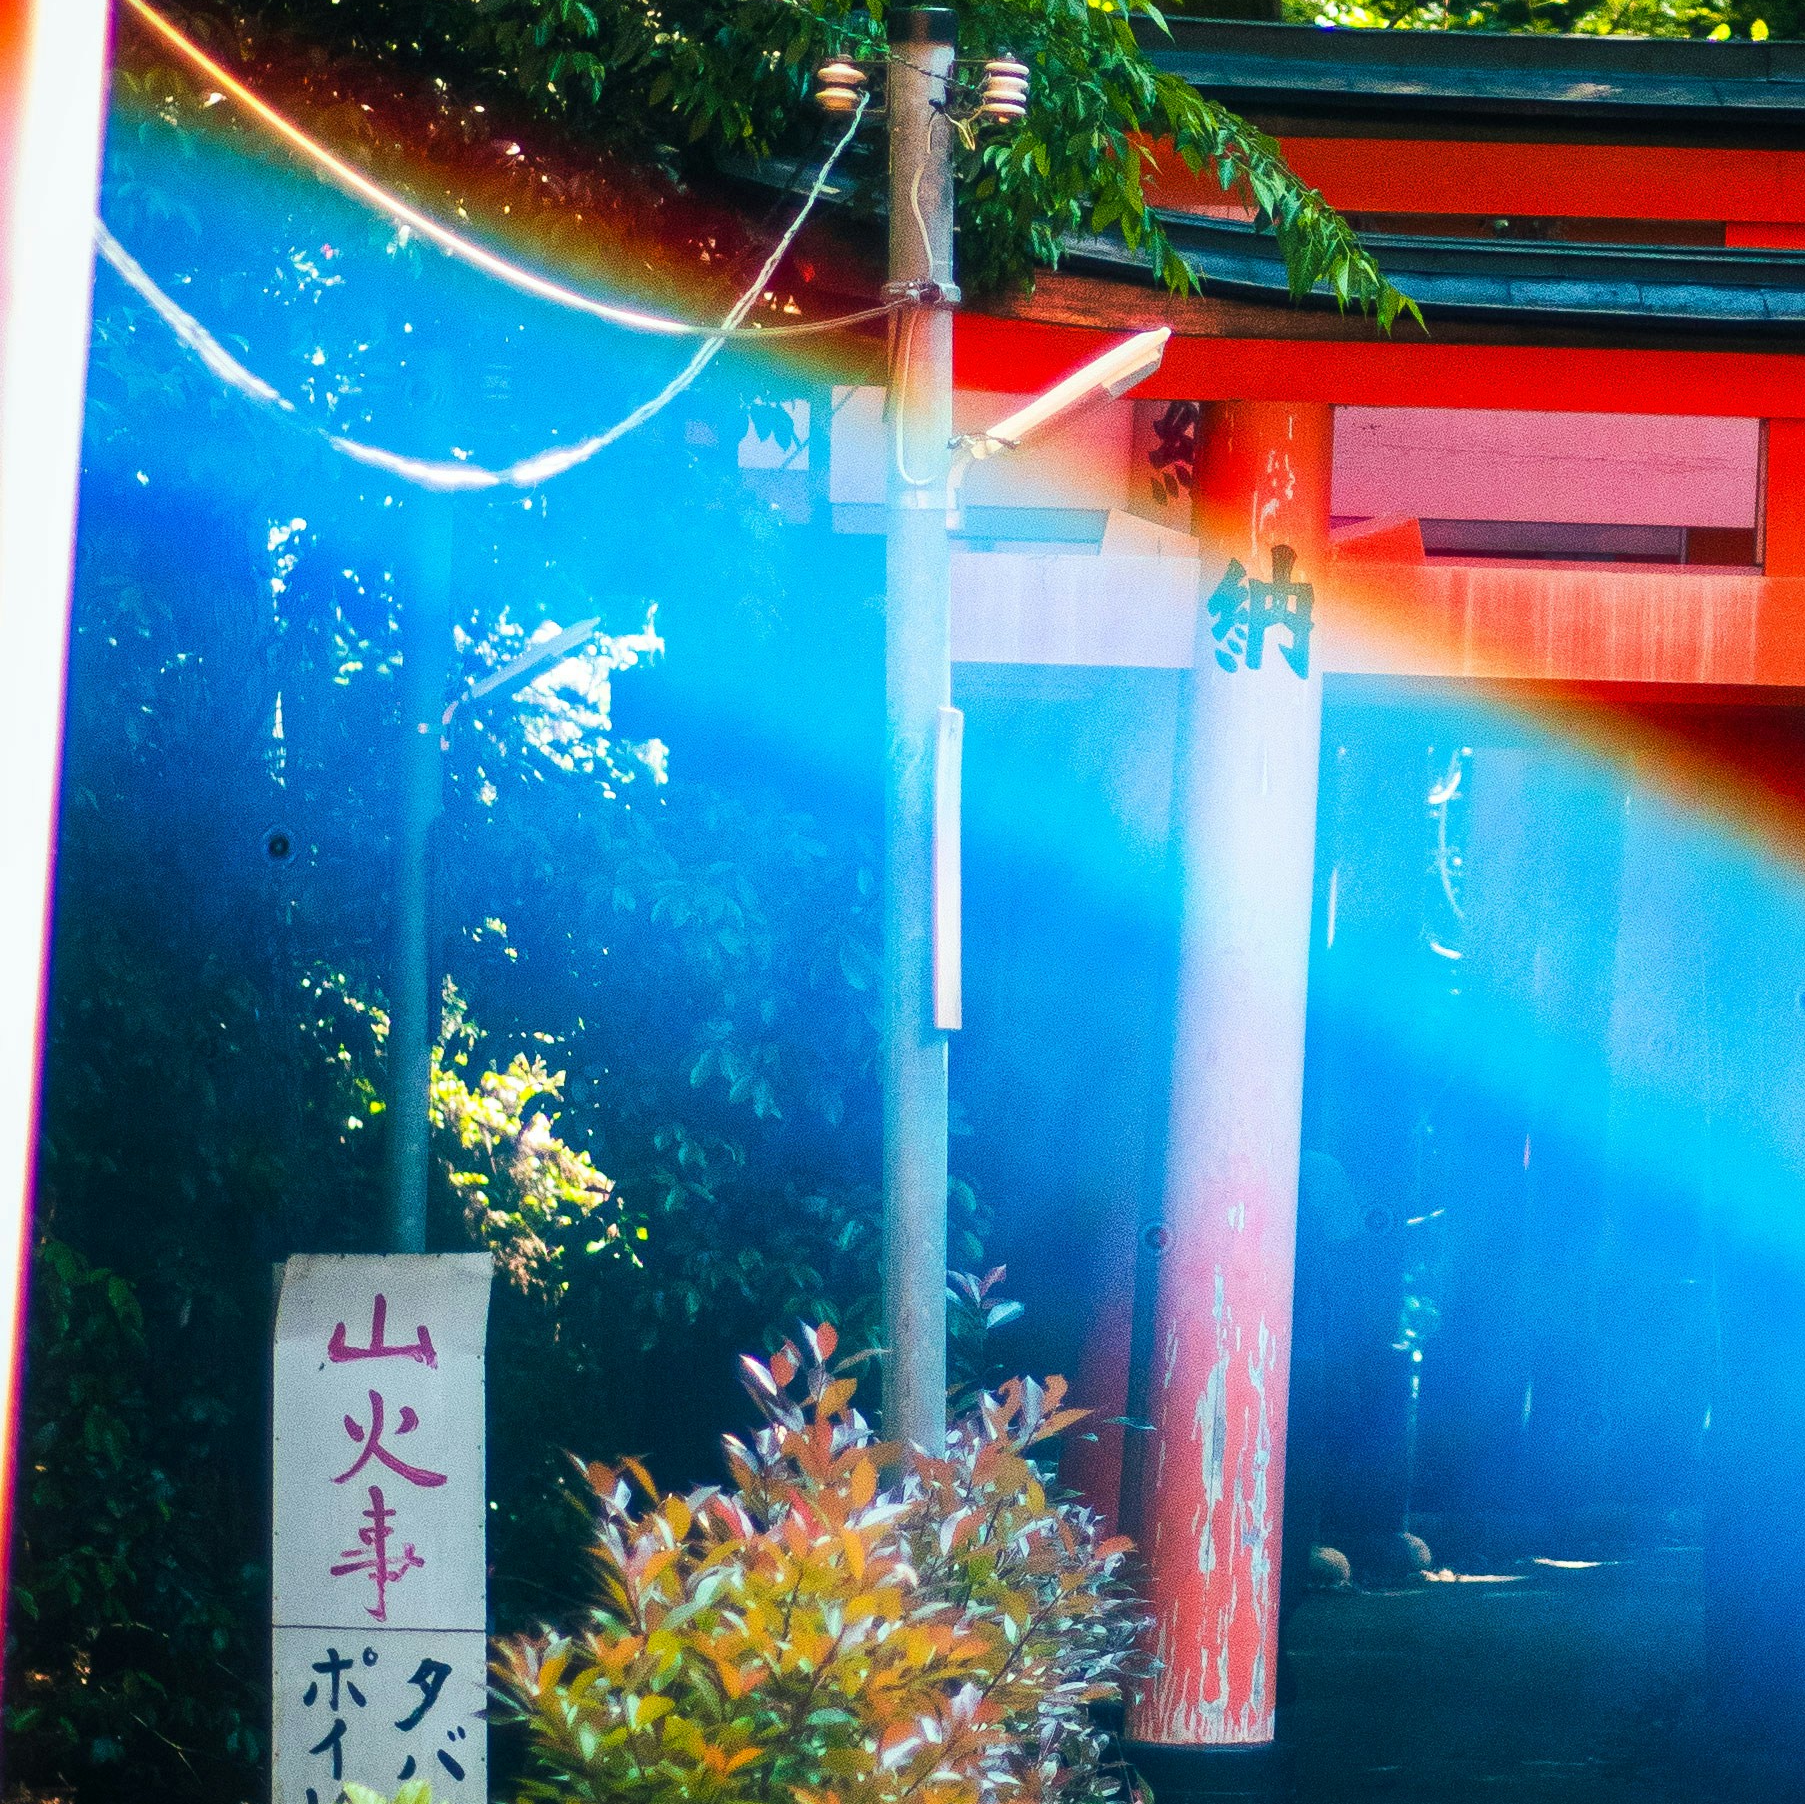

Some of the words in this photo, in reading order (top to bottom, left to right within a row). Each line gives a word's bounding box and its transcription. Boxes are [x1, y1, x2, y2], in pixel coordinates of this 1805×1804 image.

[1206, 543, 1315, 680] 納
[327, 1293, 448, 1623] 山火事
